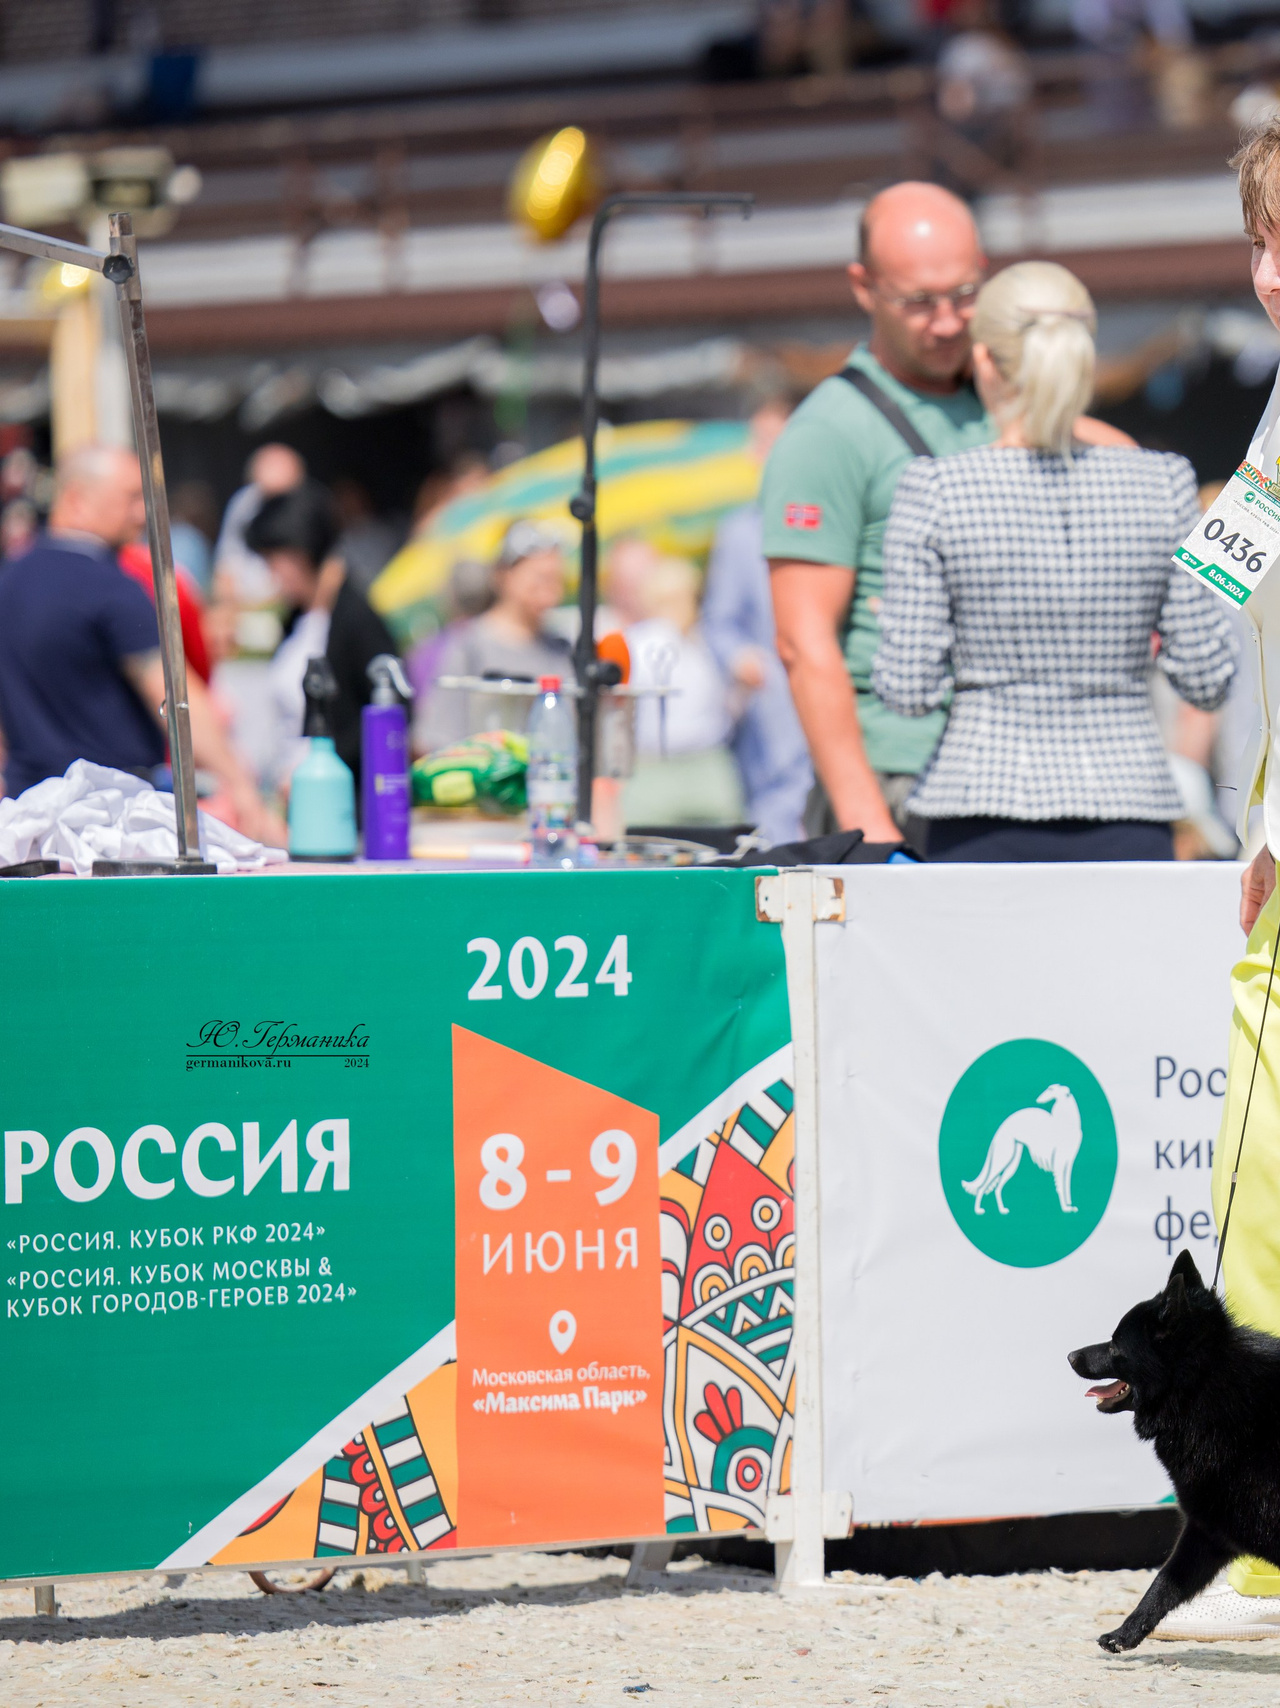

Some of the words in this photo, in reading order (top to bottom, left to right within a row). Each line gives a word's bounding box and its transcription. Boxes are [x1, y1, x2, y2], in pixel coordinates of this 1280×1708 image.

[1204, 518, 1267, 573] 0436
[1208, 569, 1245, 599] 8.06.2024
[466, 934, 633, 1001] 2024
[4, 1118, 351, 1205] РОССИЯ
[6, 1230, 121, 1254] «РОССИЯ.
[130, 1226, 204, 1249] КУБОК
[213, 1224, 258, 1245] РКФ
[265, 1221, 326, 1243] 2024»
[482, 1226, 639, 1275] ИЮНЯ
[6, 1266, 121, 1290] «РОССИЯ.
[130, 1262, 204, 1285] КУБОК
[212, 1257, 311, 1281] МОСКВЫ
[318, 1256, 333, 1276] &
[7, 1295, 83, 1318] КУБОК
[92, 1285, 289, 1315] ГОРОДОВ-ГЕРОЕВ
[297, 1282, 357, 1304] 2024»
[472, 1367, 573, 1387] Московская
[577, 1361, 650, 1381] область,
[473, 1391, 581, 1415] «Максима
[583, 1386, 648, 1414] Парк»
